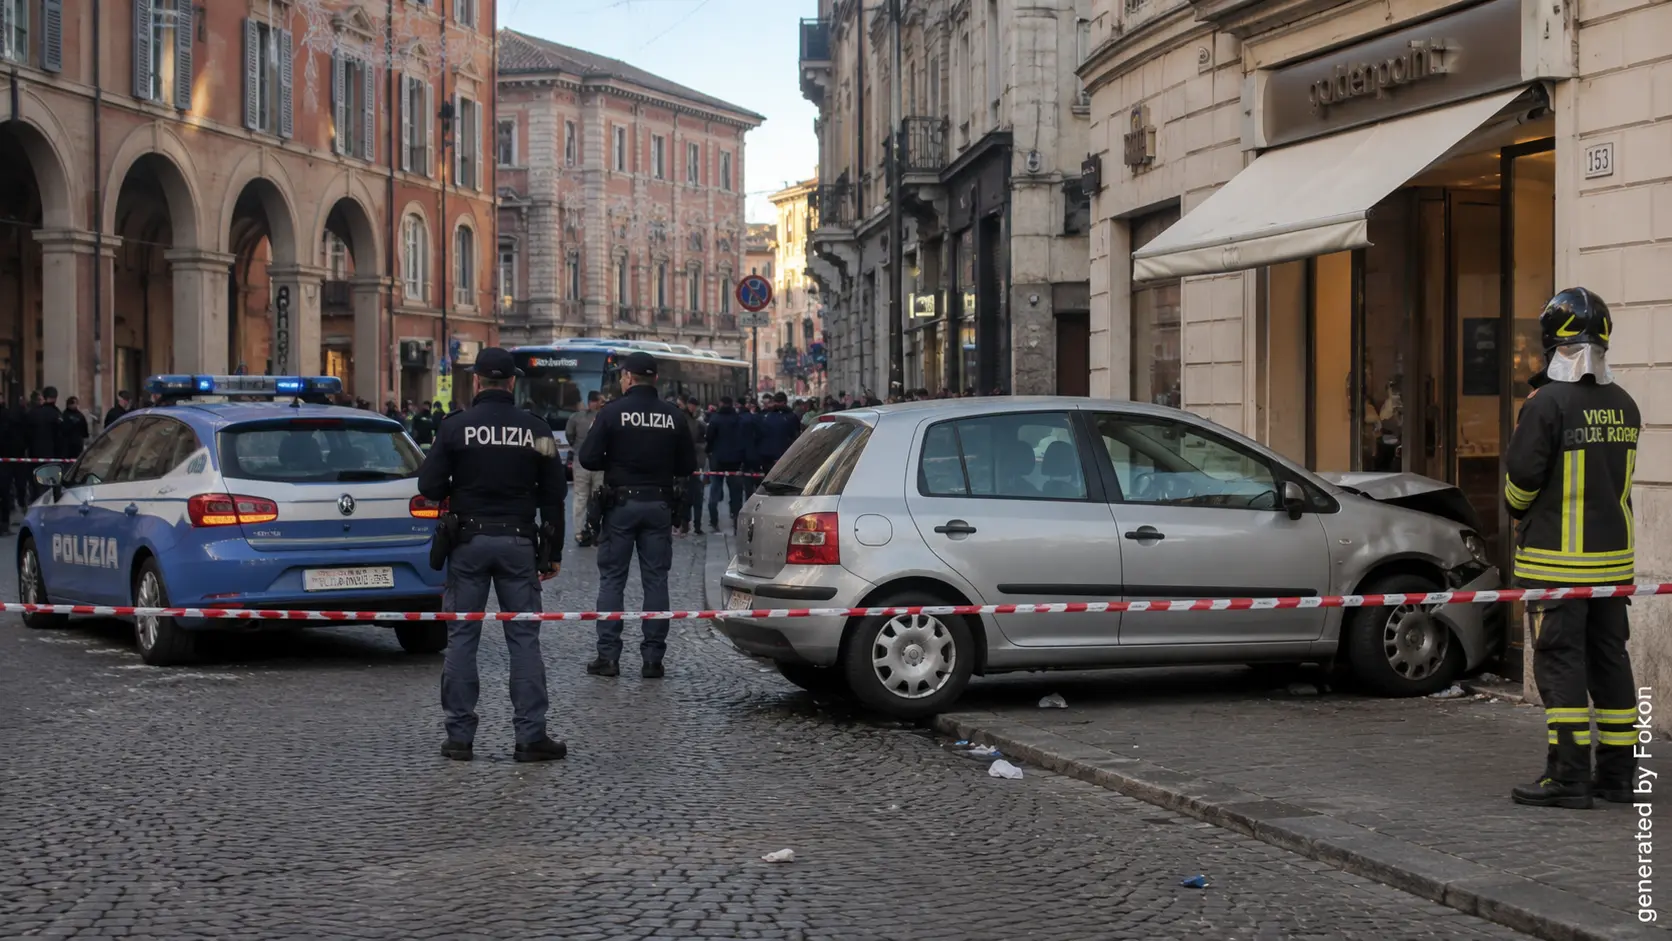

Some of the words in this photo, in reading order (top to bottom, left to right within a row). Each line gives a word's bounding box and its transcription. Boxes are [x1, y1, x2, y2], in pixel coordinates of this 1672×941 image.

[1589, 148, 1609, 171] 153
[621, 412, 675, 429] POLIZIA
[1583, 409, 1625, 425] VIGILI
[464, 426, 535, 447] POLIZIA
[52, 533, 119, 569] POLIZIA
